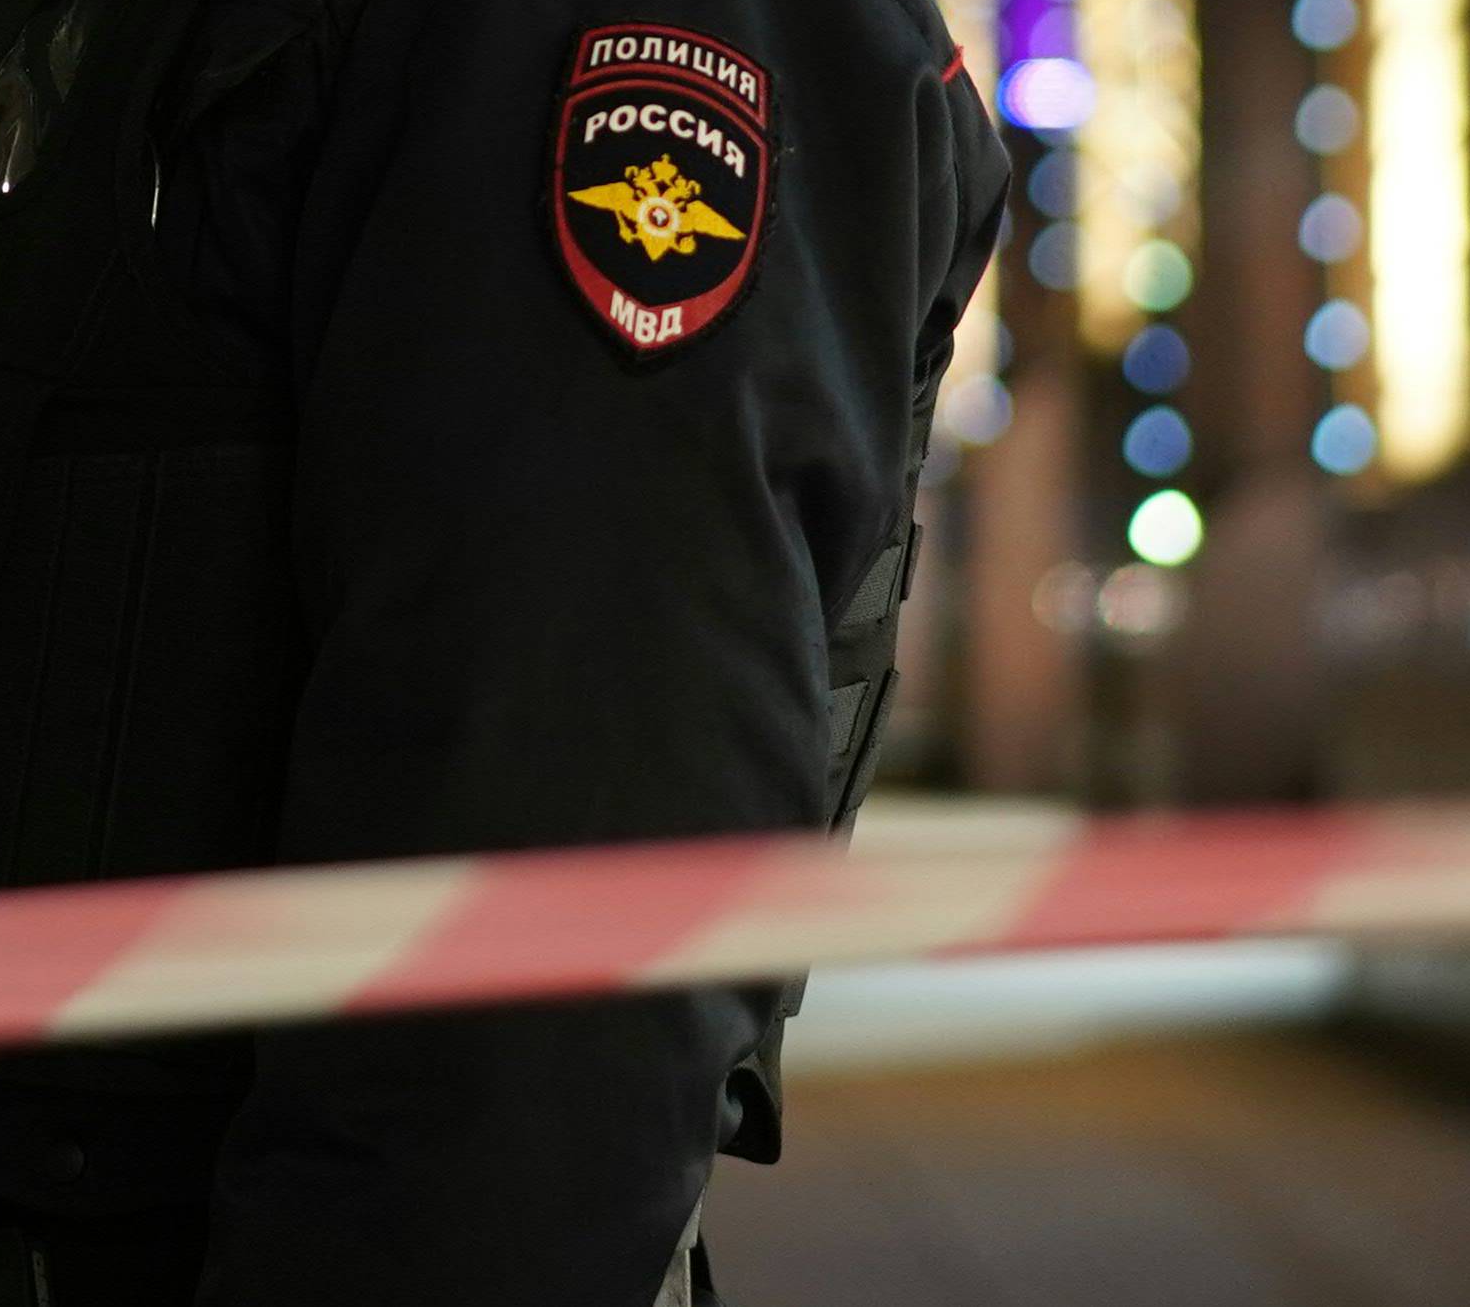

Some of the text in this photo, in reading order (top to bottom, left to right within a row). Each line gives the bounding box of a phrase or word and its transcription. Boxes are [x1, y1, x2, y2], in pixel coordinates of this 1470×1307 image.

[590, 37, 756, 102] ПОЛИЦИЯ
[584, 104, 745, 177] РОССИЯ
[610, 290, 682, 343] МВД
